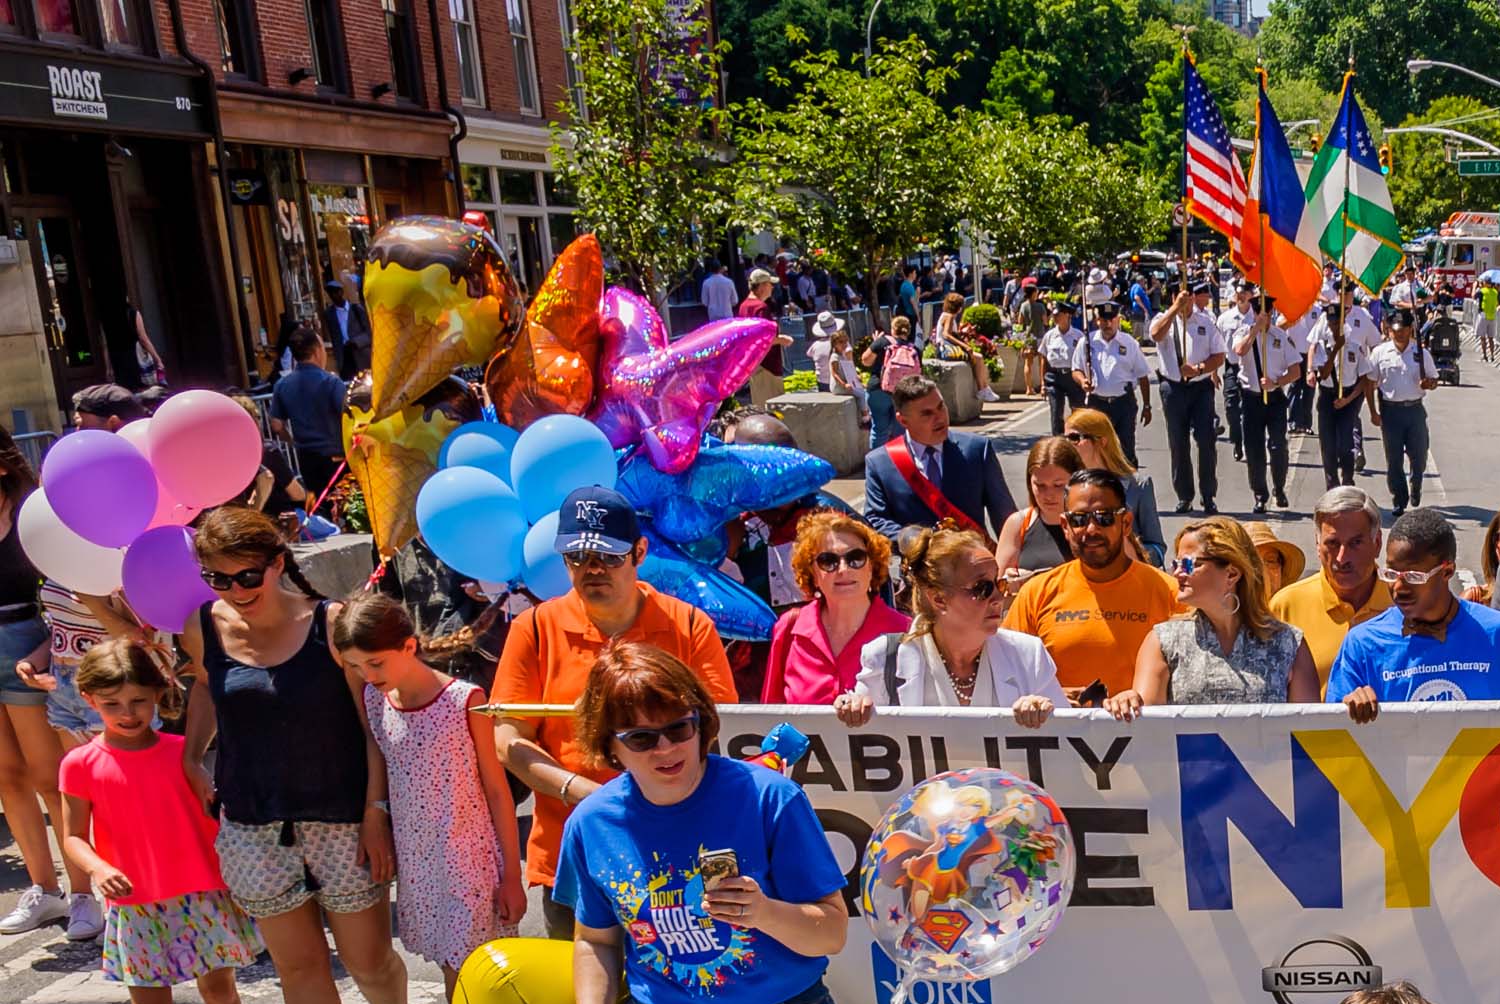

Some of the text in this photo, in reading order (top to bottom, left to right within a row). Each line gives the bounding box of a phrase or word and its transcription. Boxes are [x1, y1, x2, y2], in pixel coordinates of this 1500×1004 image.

[47, 65, 103, 101] ROAST
[61, 102, 99, 114] KITCHEN
[175, 97, 191, 111] 870
[1474, 163, 1480, 172] E
[1483, 162, 1492, 172] 17
[575, 500, 608, 530] NY
[1055, 607, 1148, 623] NYC Service
[1382, 661, 1491, 682] Occupational Therapy
[650, 889, 684, 908] DON'T
[651, 905, 700, 933] HIDE
[698, 917, 716, 929] THE
[659, 927, 726, 957] PRIDE
[1274, 969, 1372, 987] NISSAN
